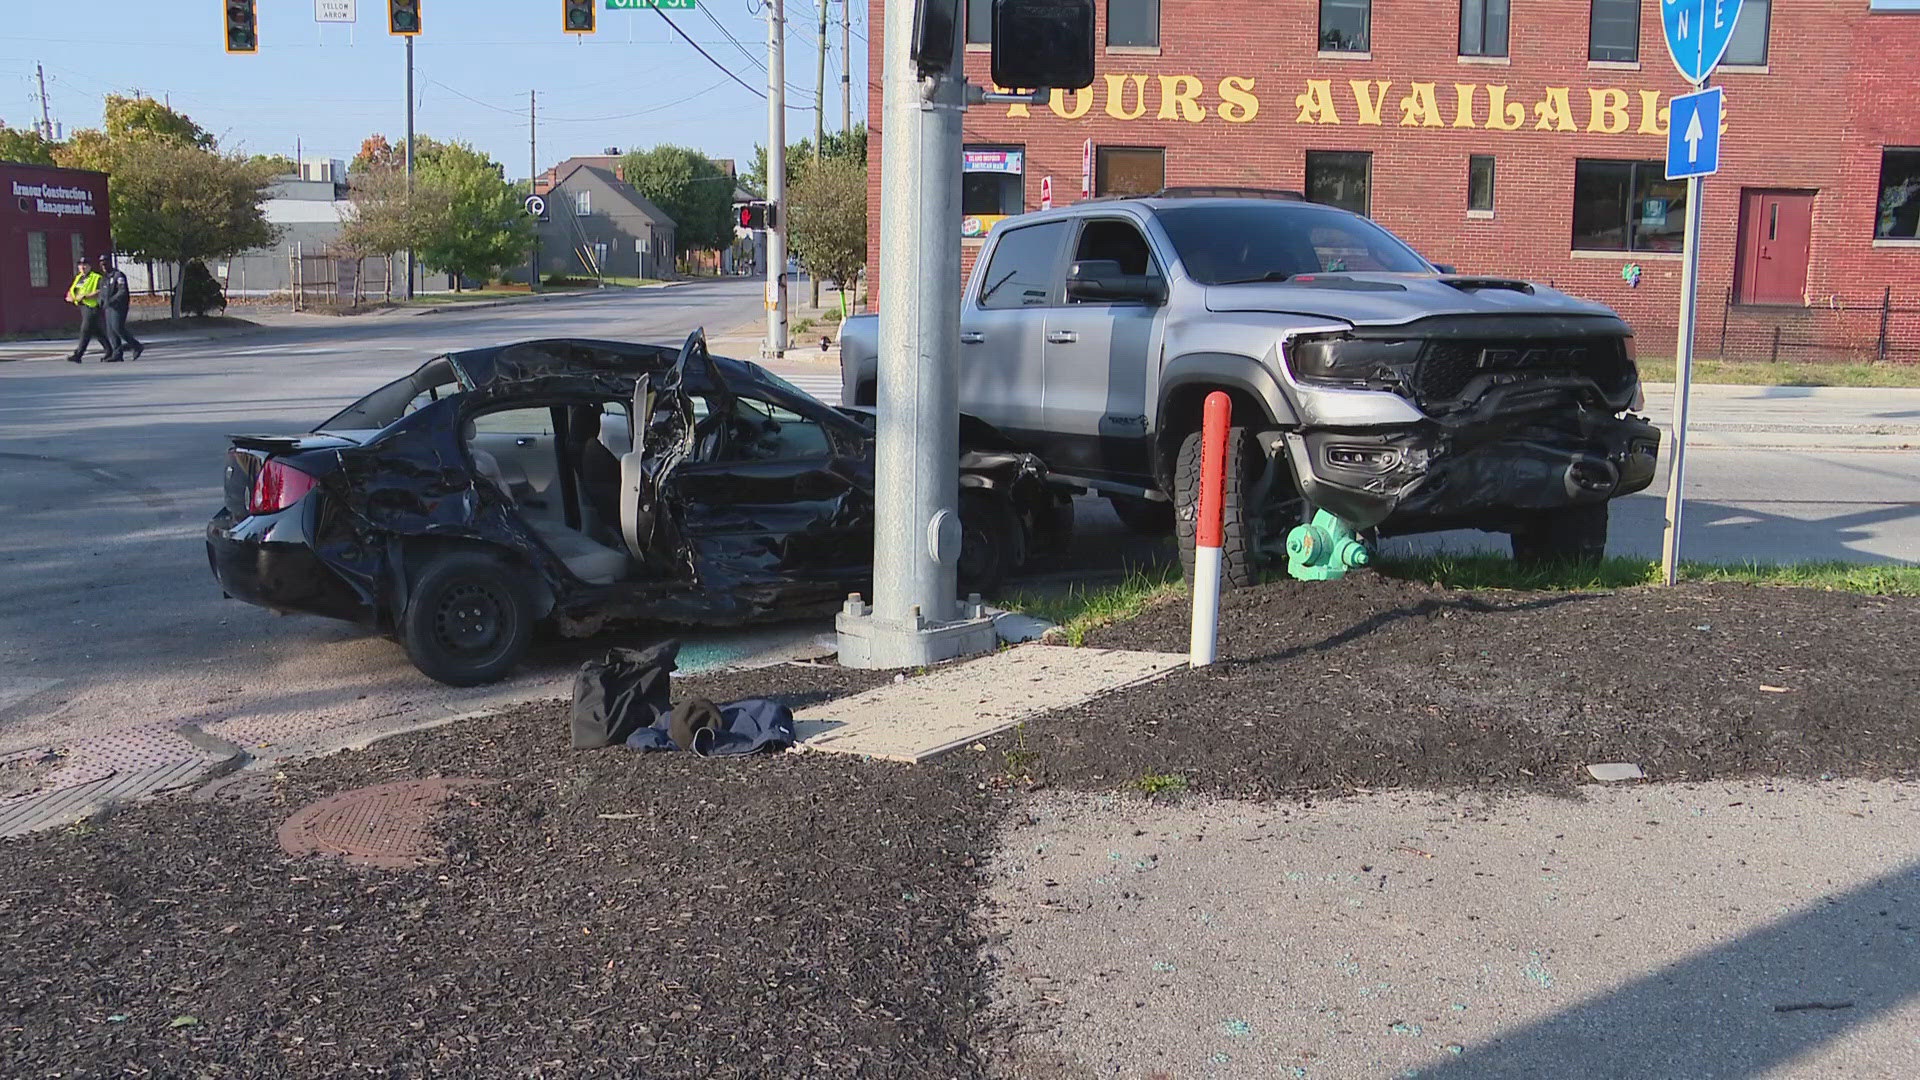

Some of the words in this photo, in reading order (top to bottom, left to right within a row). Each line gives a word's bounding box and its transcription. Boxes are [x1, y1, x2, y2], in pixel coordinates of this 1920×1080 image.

[1295, 79, 1728, 136] AVAILABL
[12, 181, 41, 197] Armour
[42, 183, 87, 200] Construction
[36, 199, 82, 217] Management
